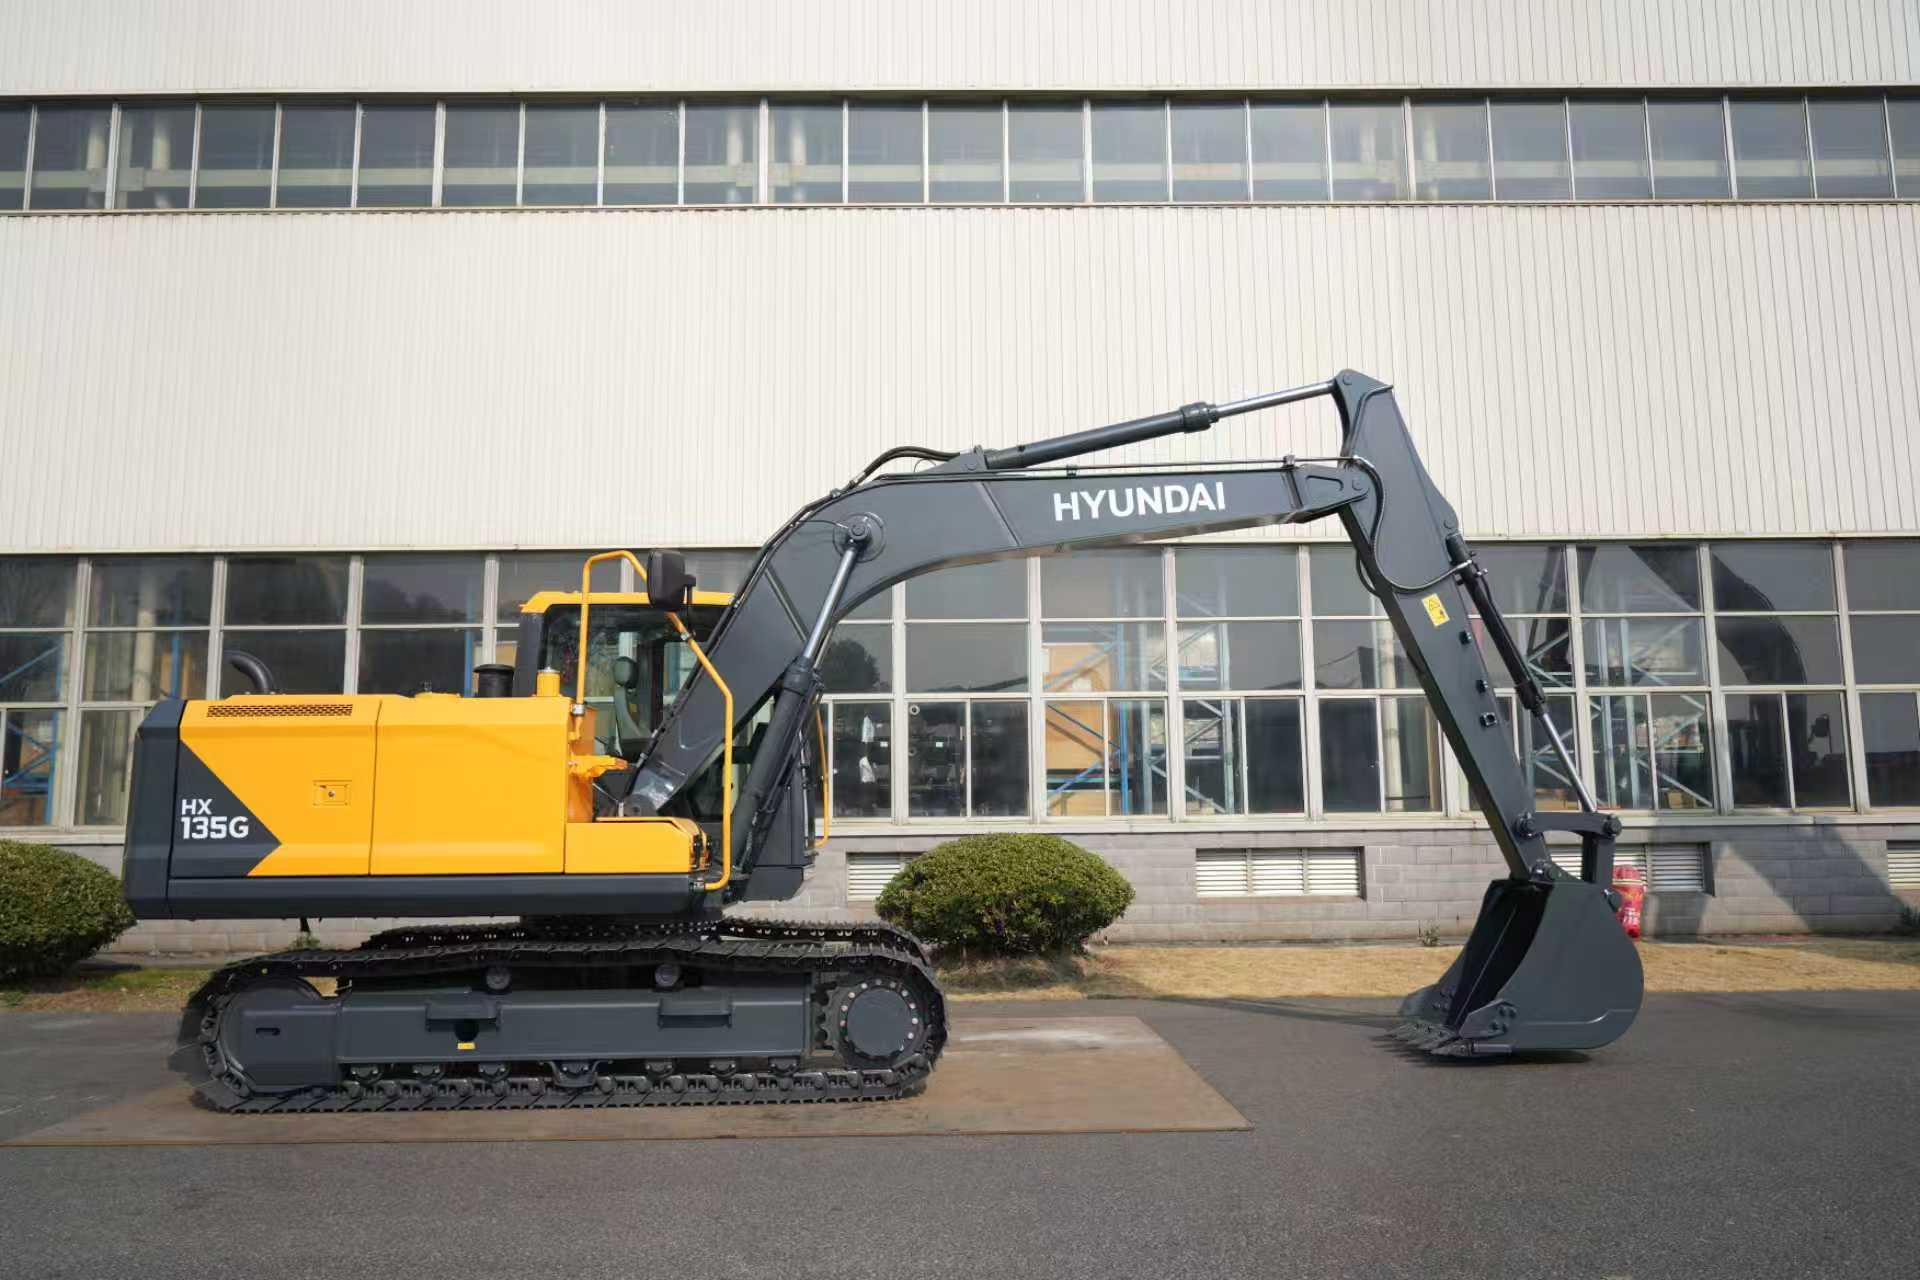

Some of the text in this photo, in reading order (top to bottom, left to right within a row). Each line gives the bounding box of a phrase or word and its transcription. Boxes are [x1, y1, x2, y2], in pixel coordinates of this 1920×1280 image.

[1053, 481, 1227, 522] HYUNDAI
[181, 798, 213, 815] HX
[180, 815, 249, 839] 135G
